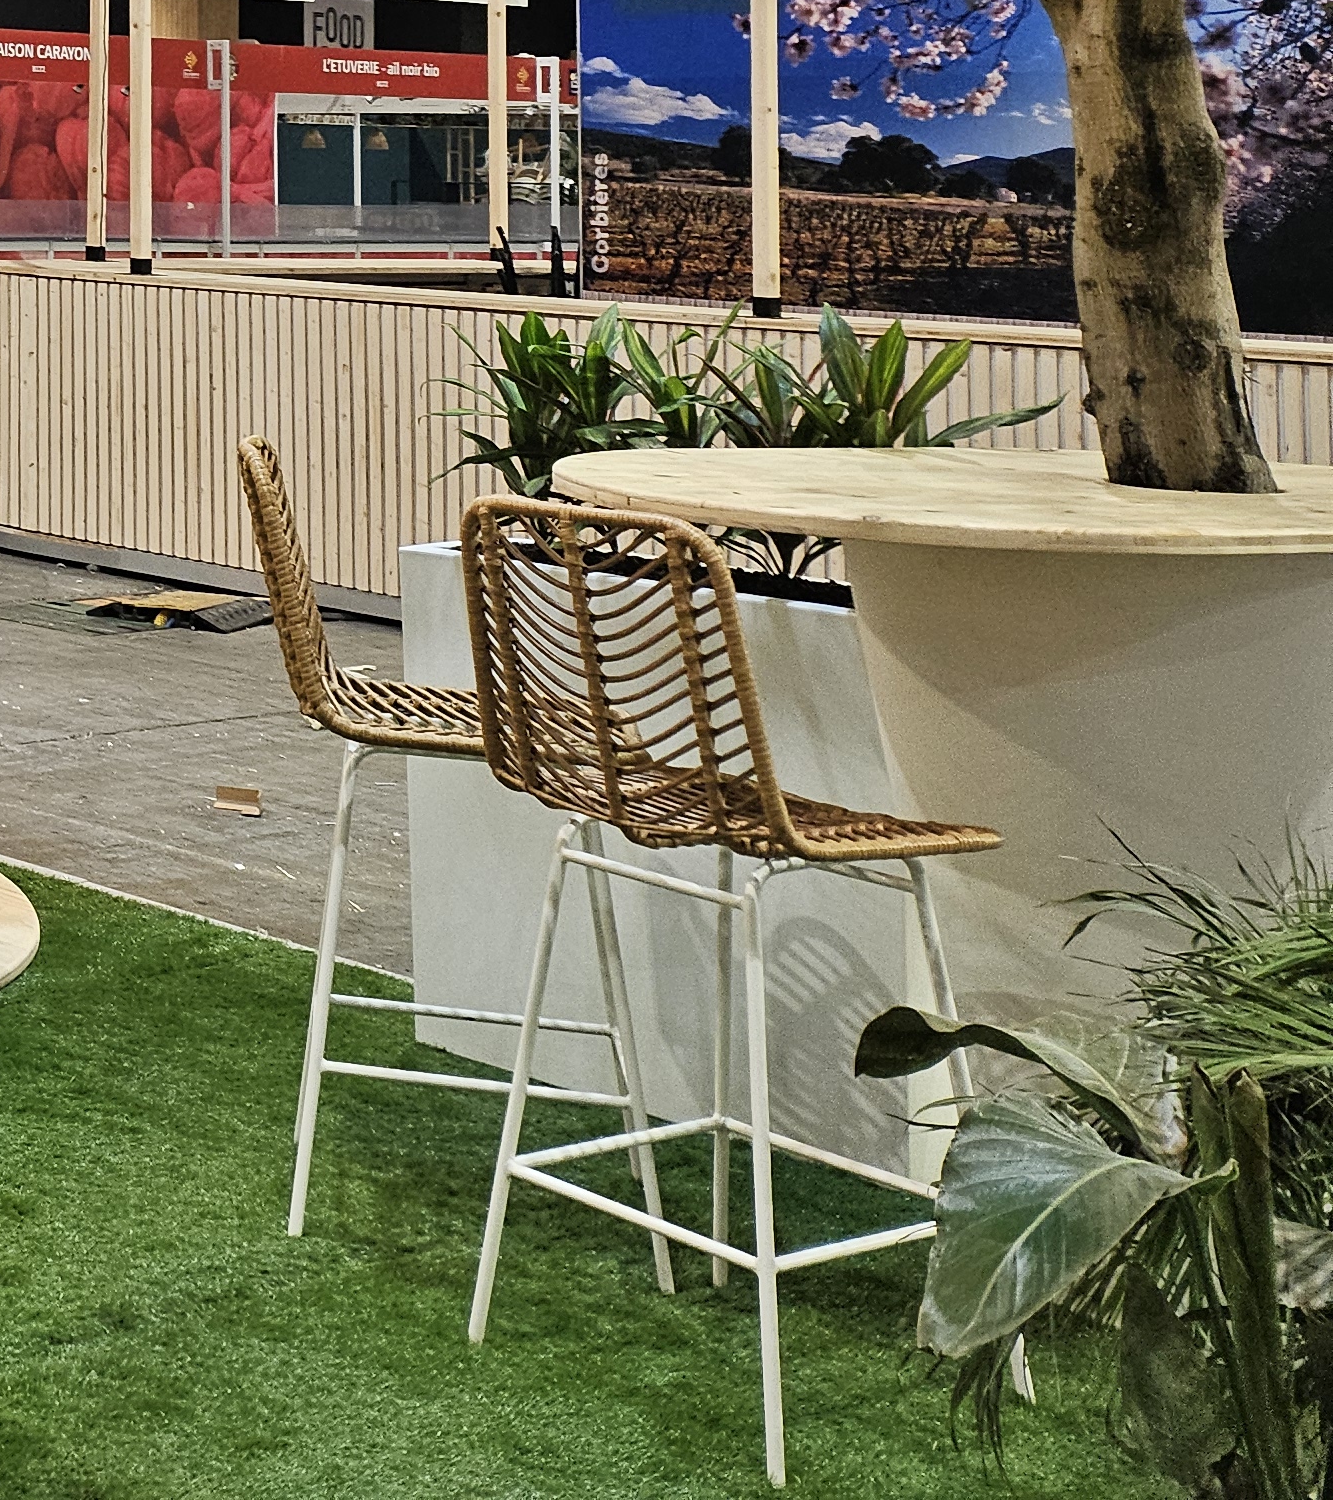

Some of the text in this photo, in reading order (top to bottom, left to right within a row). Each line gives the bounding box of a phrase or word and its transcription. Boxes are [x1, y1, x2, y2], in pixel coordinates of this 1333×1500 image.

[312, 7, 364, 49] FOOD
[36, 44, 91, 62] CARAYON
[322, 58, 440, 78] L'ETUVERIE ail noir bio
[590, 151, 610, 275] Corbières
